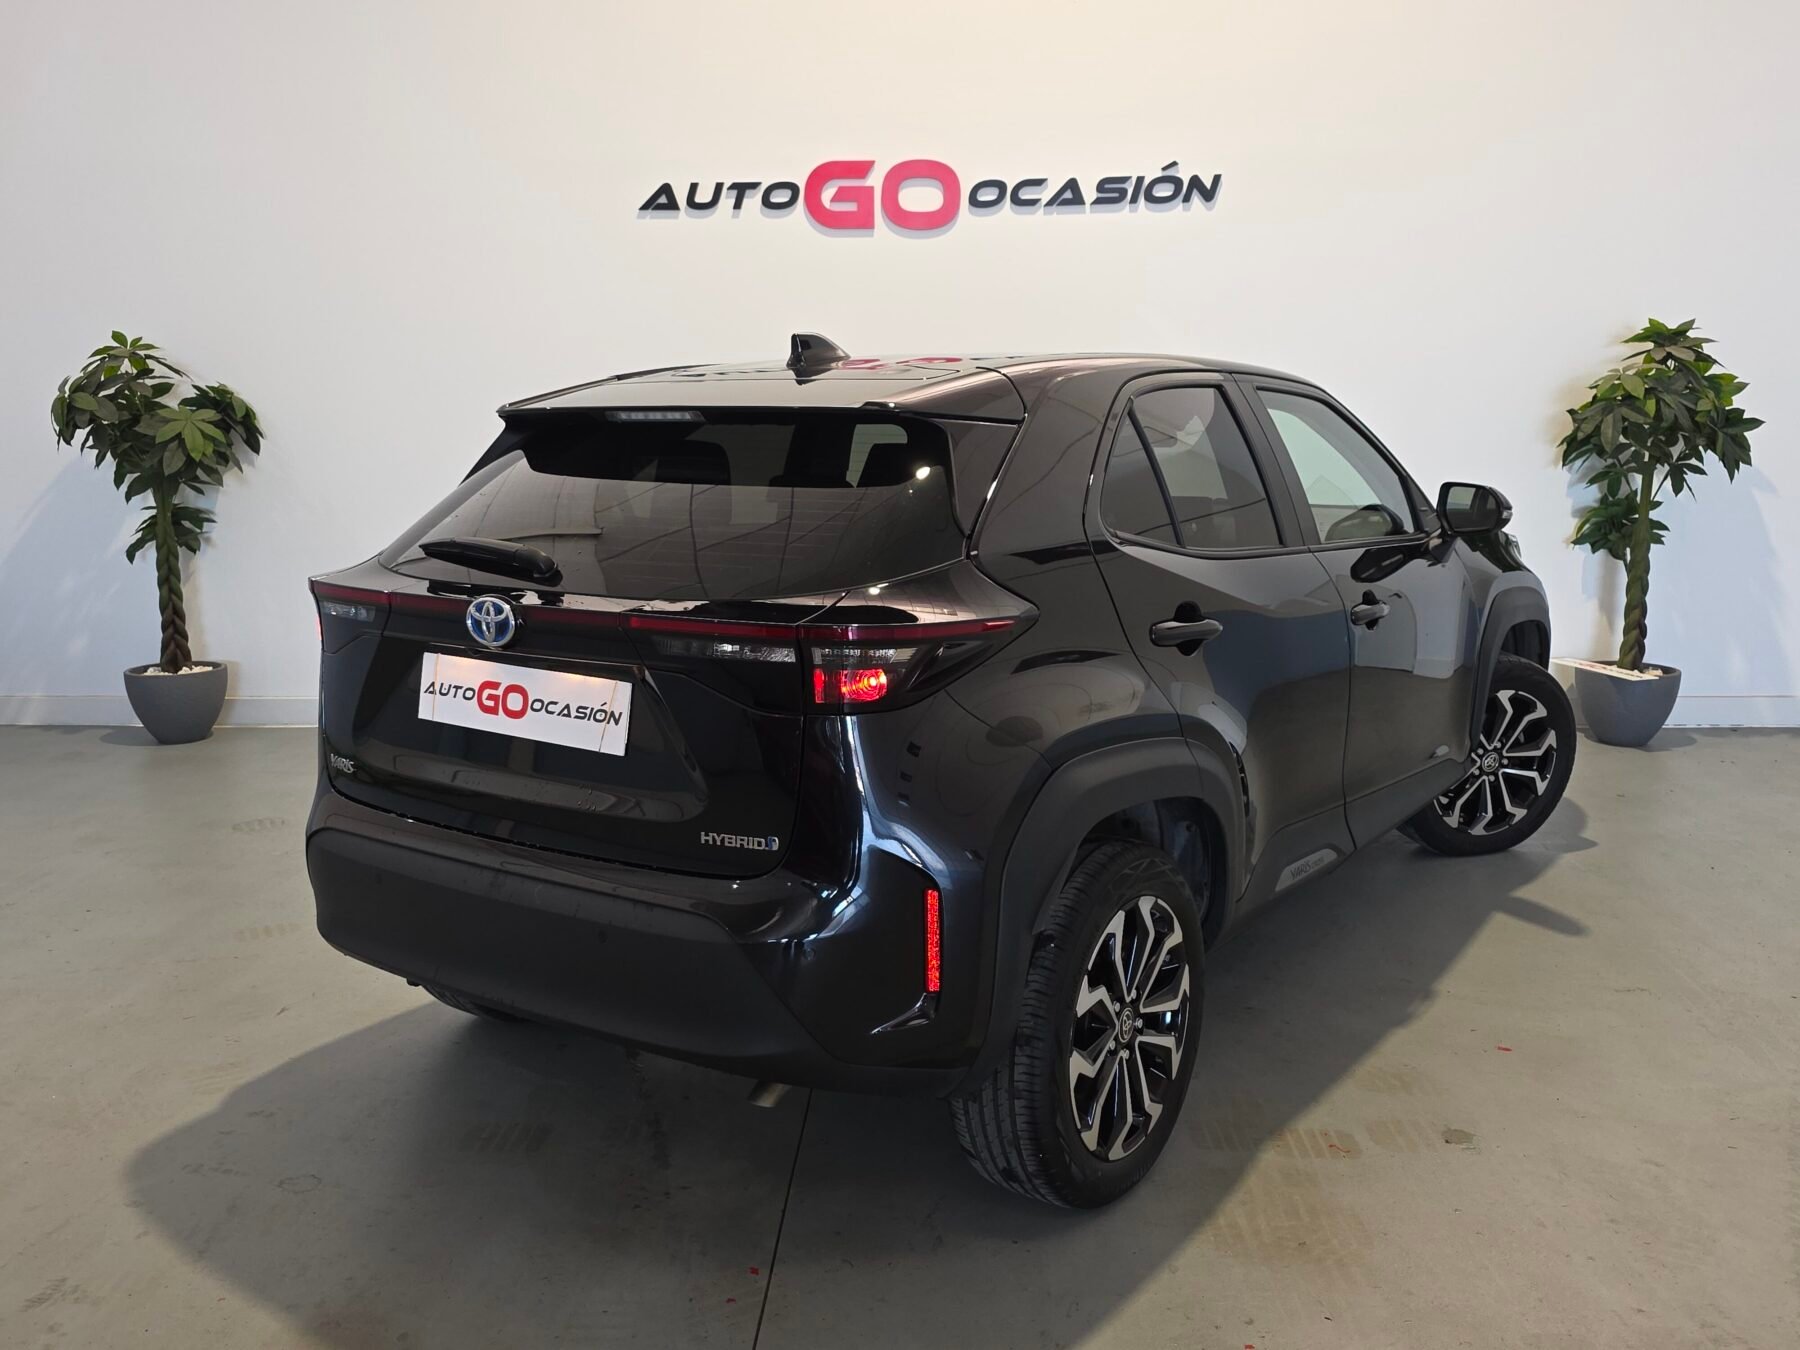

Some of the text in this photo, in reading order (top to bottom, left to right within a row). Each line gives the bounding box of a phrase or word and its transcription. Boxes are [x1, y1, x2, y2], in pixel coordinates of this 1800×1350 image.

[638, 159, 1222, 230] AUTO GO OCASIÓN
[423, 680, 623, 726] AUTO GO OCASIÓN
[700, 831, 766, 850] HYBRID
